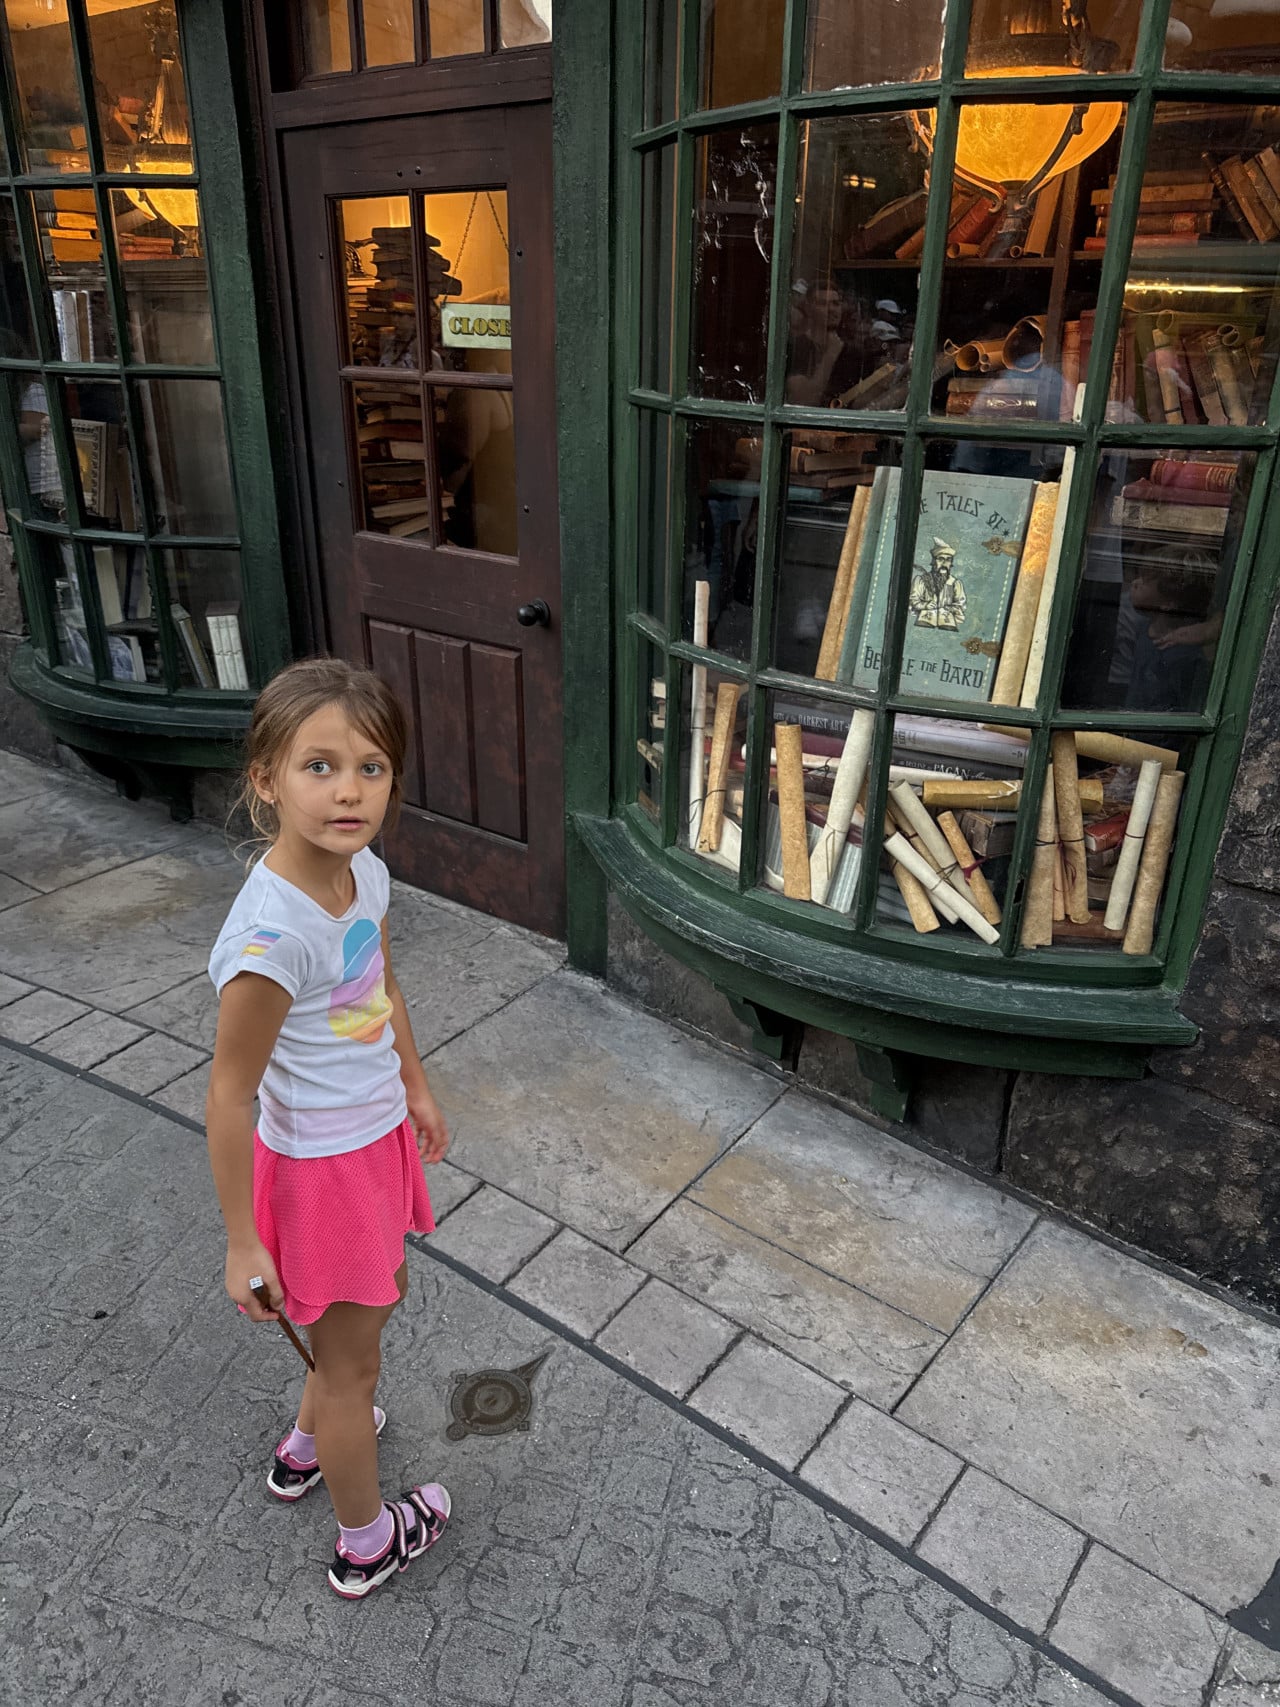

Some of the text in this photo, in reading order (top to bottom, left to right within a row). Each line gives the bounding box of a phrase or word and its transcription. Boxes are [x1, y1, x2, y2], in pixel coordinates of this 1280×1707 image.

[448, 316, 512, 337] CLOSE
[936, 490, 985, 517] TALES
[939, 658, 984, 689] BARD
